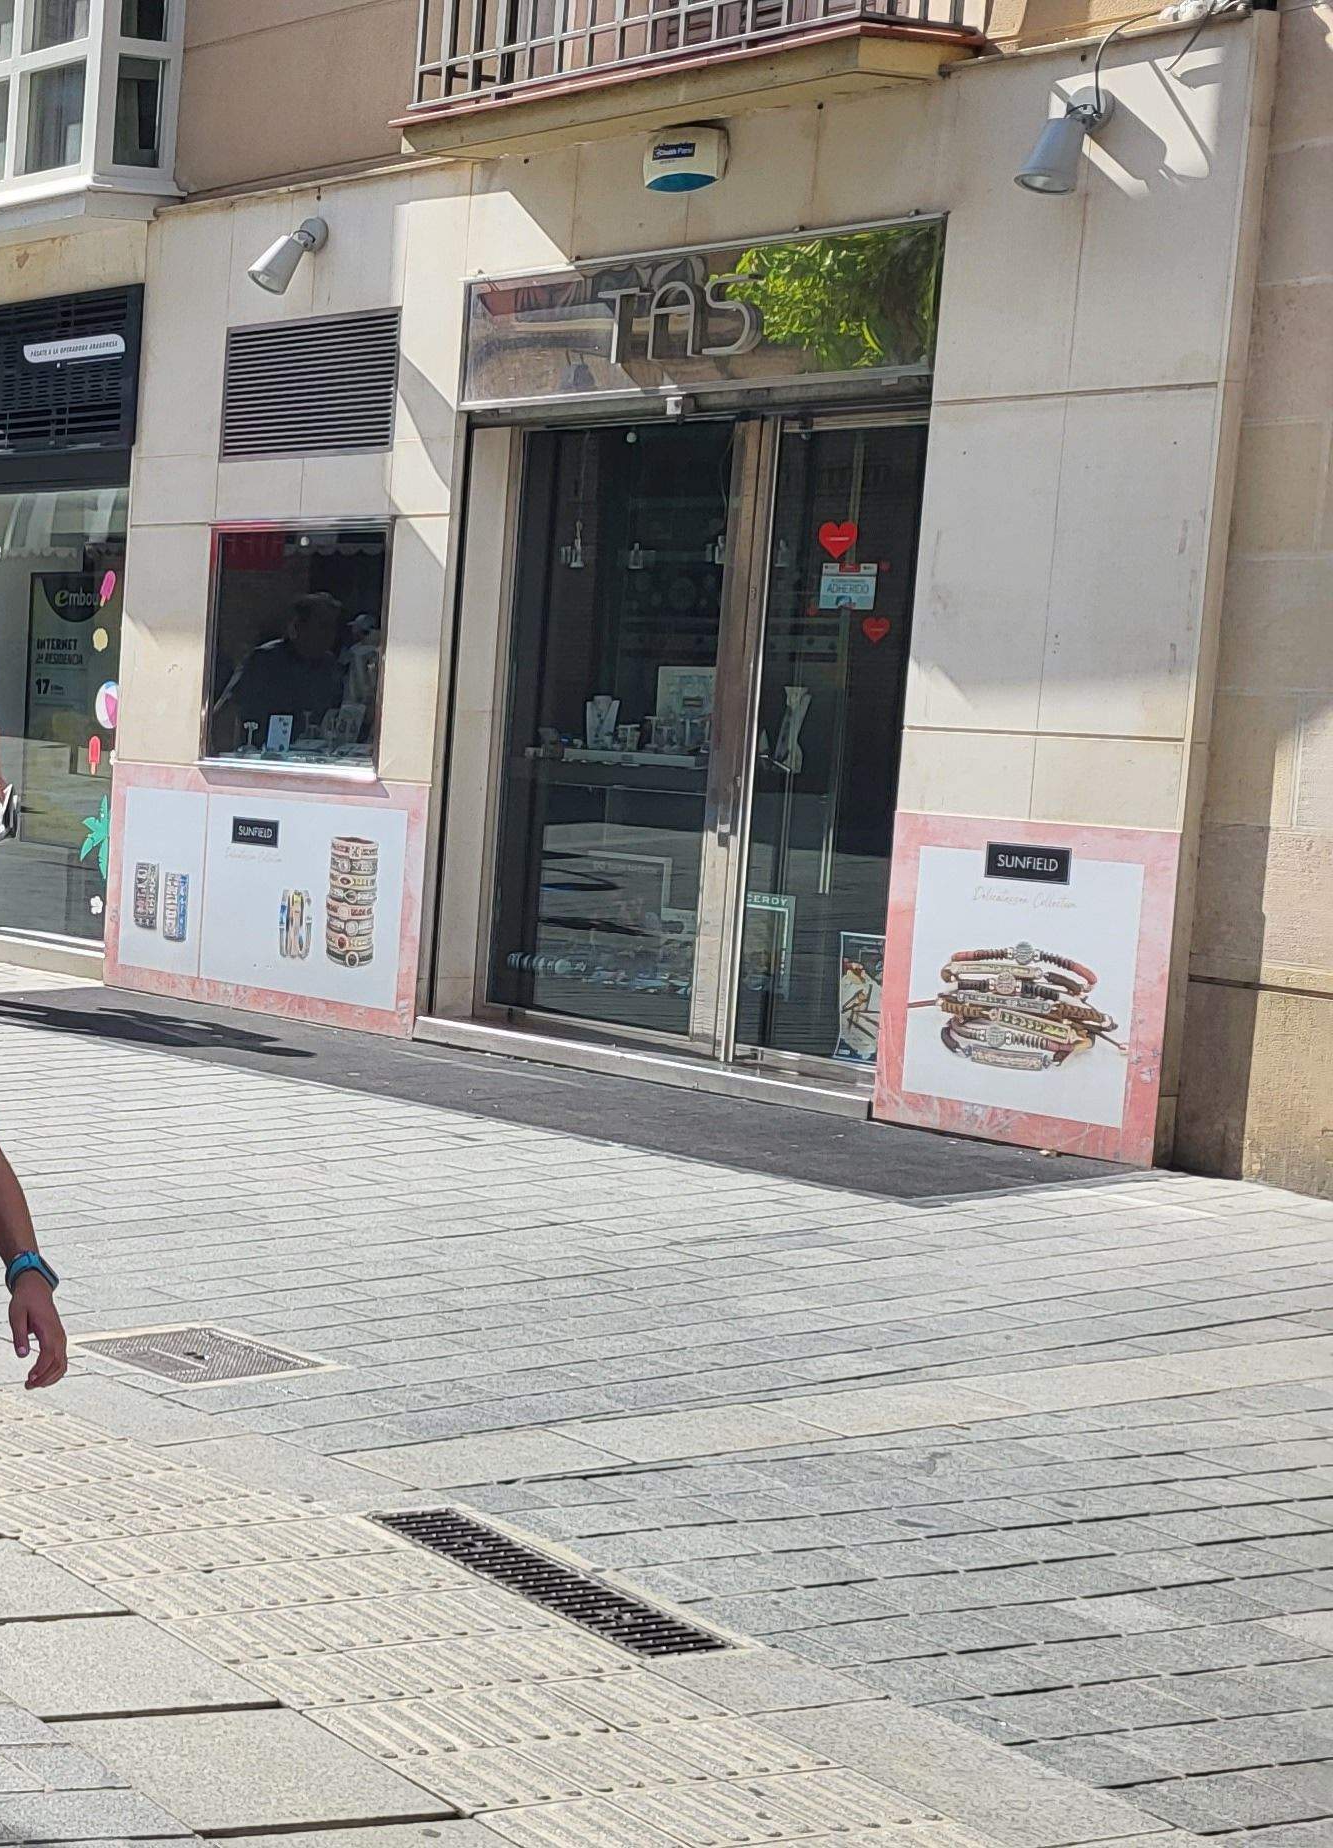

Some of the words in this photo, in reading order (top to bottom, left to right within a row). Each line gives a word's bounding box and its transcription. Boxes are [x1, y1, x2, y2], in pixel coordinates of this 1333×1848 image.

[598, 273, 763, 364] TAS
[37, 638, 78, 650] INTERNET
[44, 653, 83, 665] RESIDENCIA
[35, 678, 51, 694] 17
[238, 825, 273, 839] SUNFIELD
[997, 854, 1059, 872] SUNFIELD
